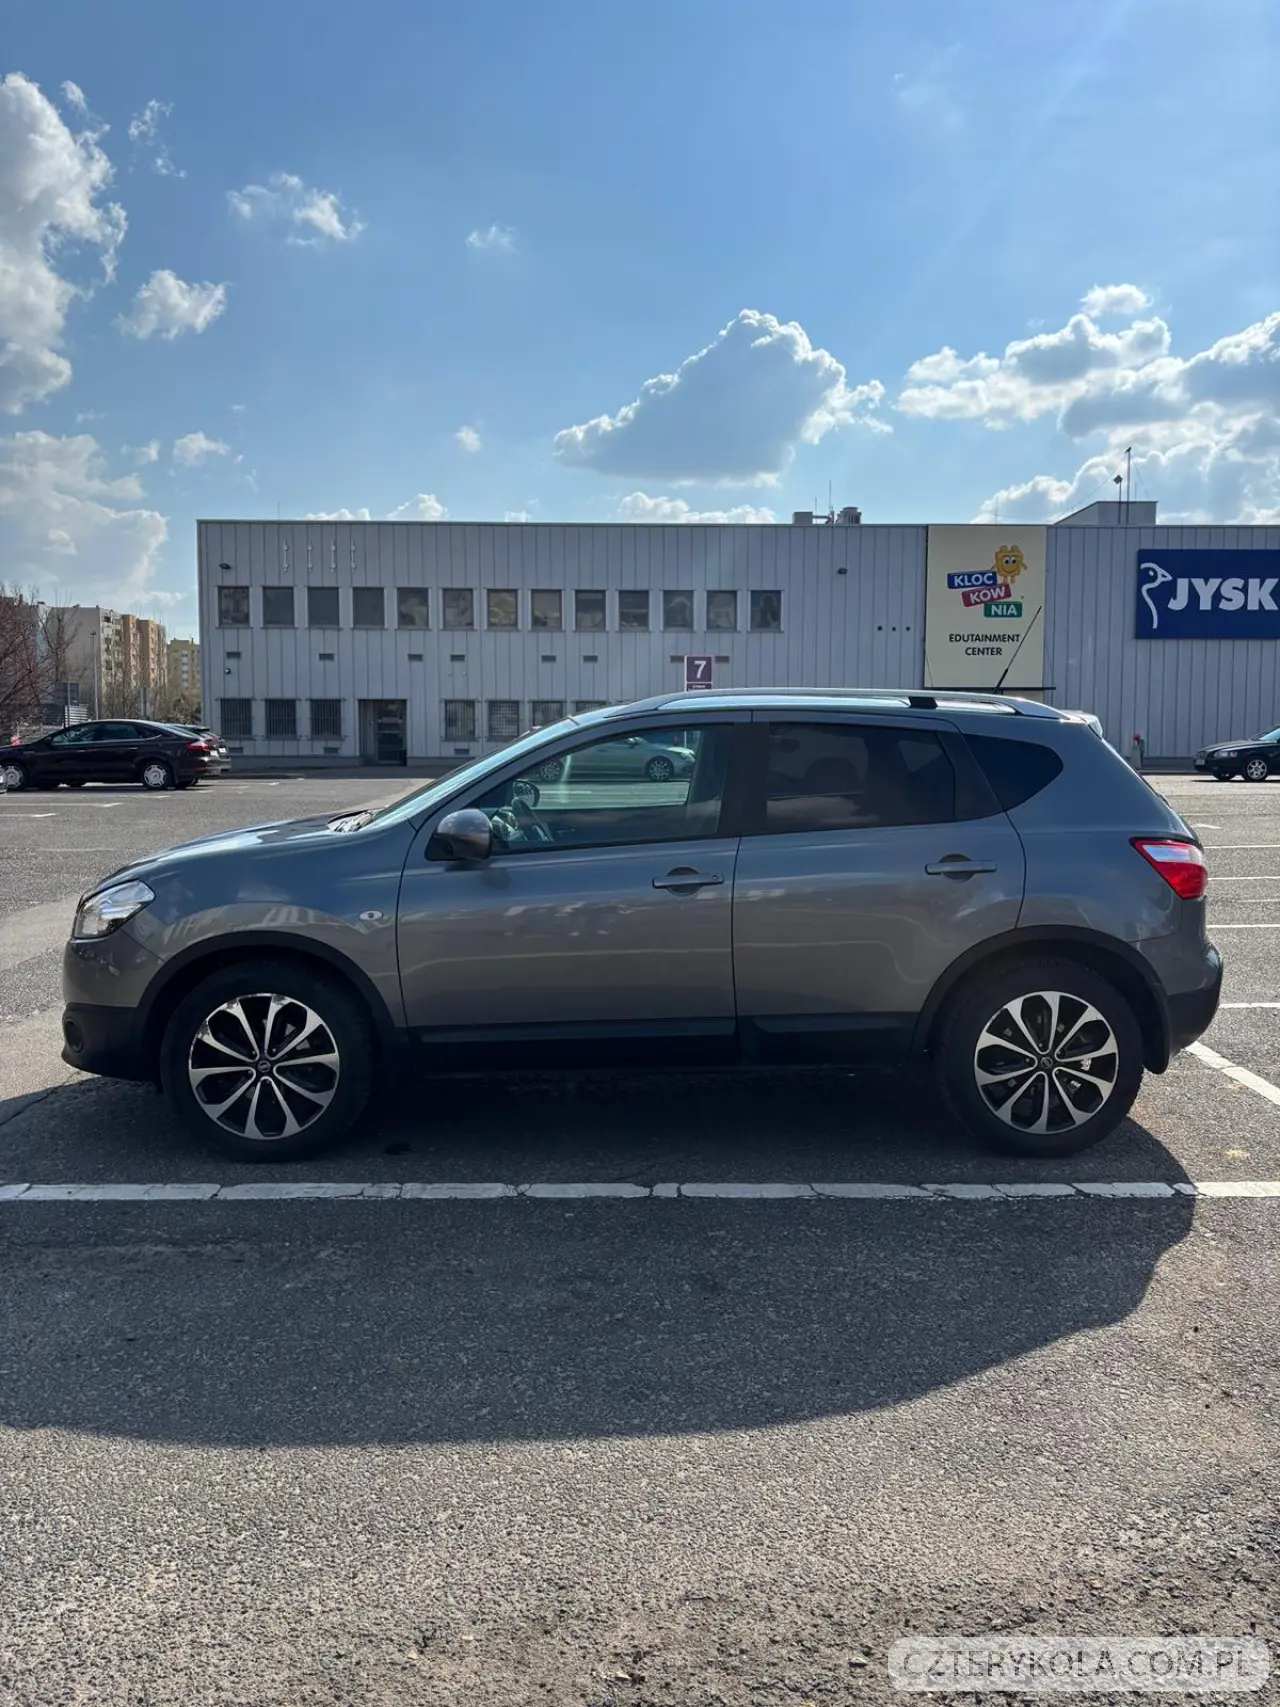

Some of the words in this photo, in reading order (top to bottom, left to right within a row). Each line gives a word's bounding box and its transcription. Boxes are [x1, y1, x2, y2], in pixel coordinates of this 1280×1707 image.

[954, 573, 993, 587] KLOC
[970, 587, 1006, 604] KOW
[1168, 578, 1279, 610] JYSK
[991, 604, 1017, 615] NIA
[949, 634, 1020, 643] EDUTAINMENT
[965, 647, 1002, 656] CENTER
[694, 660, 706, 679] 7
